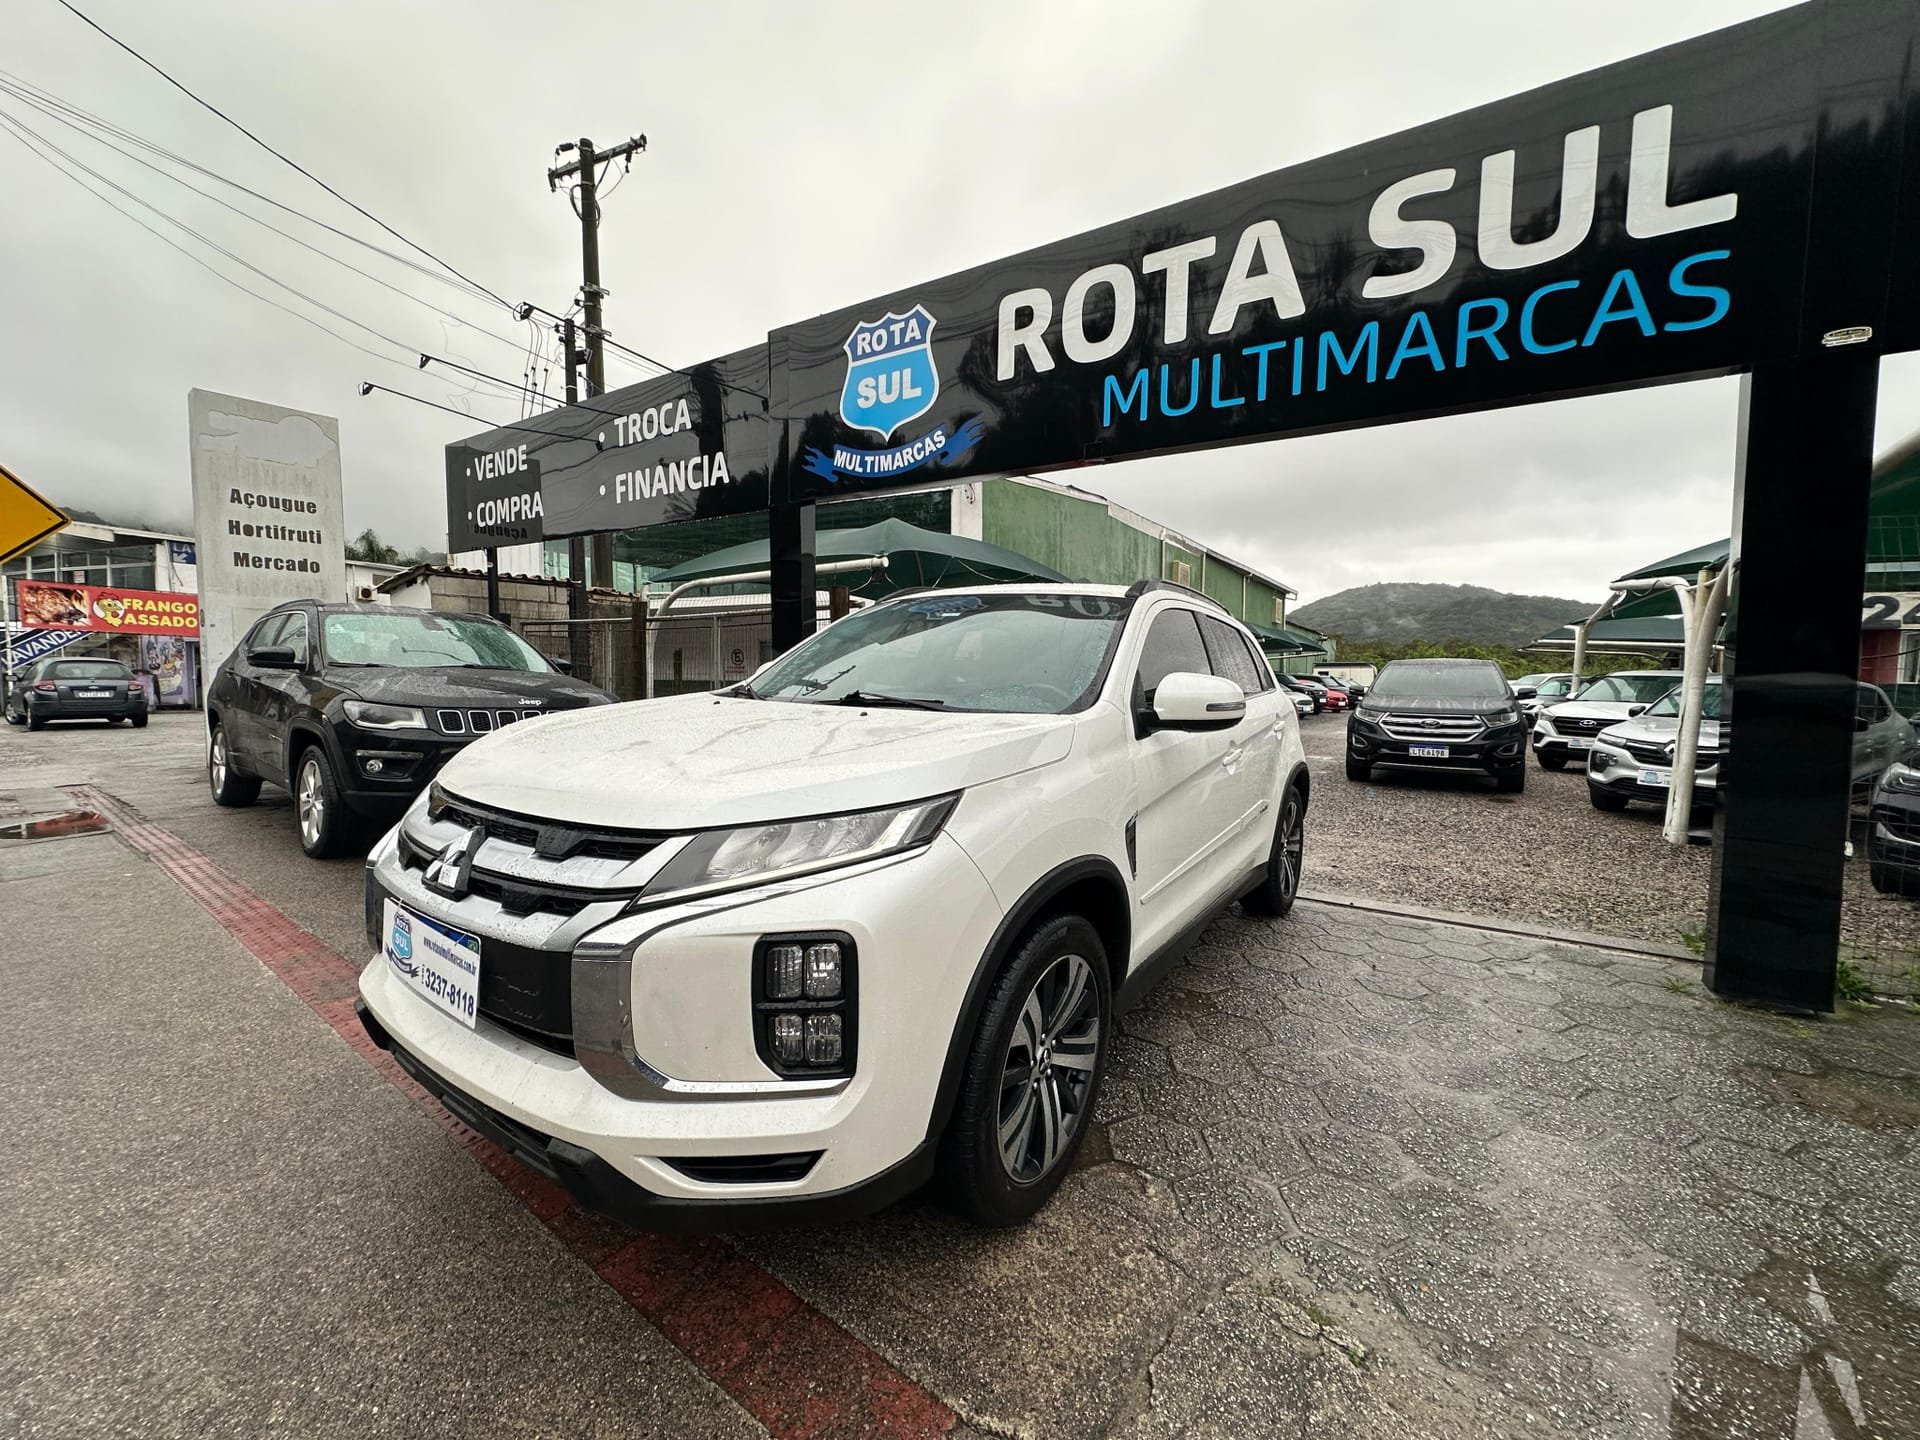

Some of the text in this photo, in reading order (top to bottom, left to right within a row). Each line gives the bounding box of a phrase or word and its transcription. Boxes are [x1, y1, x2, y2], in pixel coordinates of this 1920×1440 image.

[997, 104, 1739, 382] ROTA SUL
[855, 316, 923, 357] ROTA
[1103, 248, 1732, 429] MULTIMARCAS
[856, 366, 923, 410] SUL
[613, 397, 693, 448] TROCA
[474, 443, 529, 482] VENDE
[832, 429, 947, 474] MULTIMARCAS
[614, 451, 731, 506] FINANCIA
[230, 488, 318, 515] Açougue
[475, 488, 545, 529] COMPRA
[228, 519, 322, 546] Hortifruti
[233, 551, 321, 574] Mercado
[122, 598, 198, 614] FRANGO
[123, 613, 199, 628] ASSADO
[518, 697, 542, 706] Jeep
[395, 933, 409, 951] SUL
[396, 918, 409, 932] ROTA
[425, 968, 475, 1017] 3237-8118
